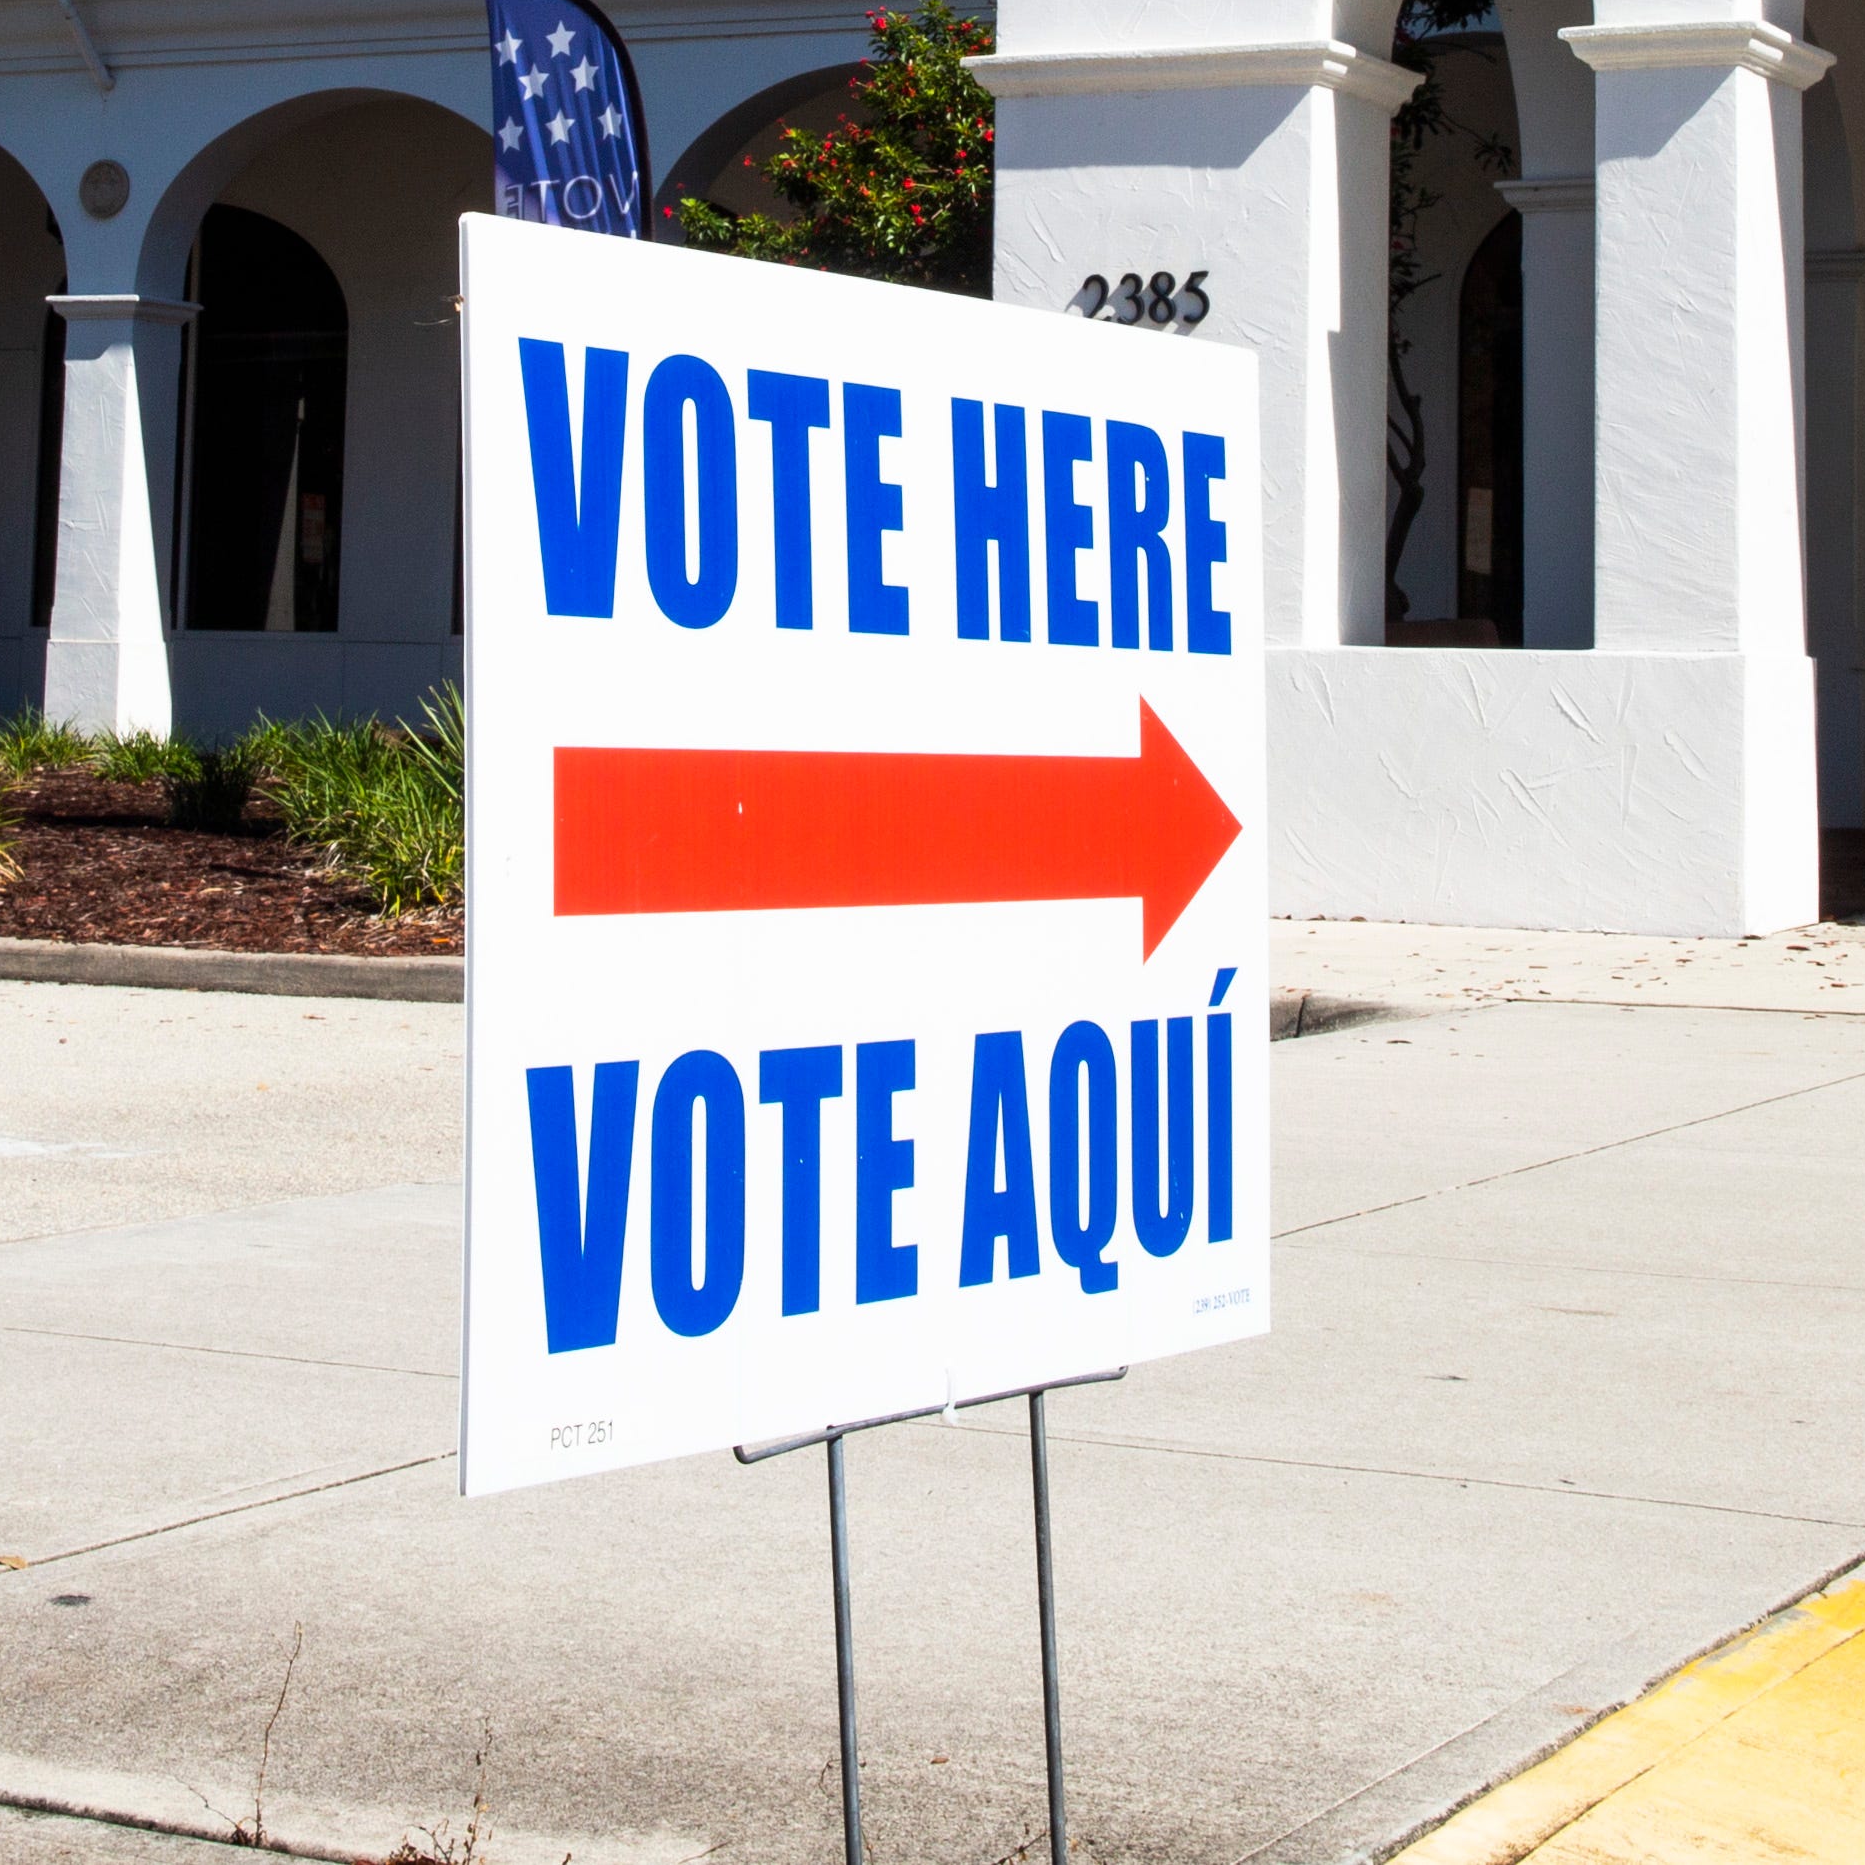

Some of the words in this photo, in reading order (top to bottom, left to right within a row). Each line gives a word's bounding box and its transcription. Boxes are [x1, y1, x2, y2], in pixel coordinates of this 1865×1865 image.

[1083, 271, 1210, 324] 2385
[518, 337, 909, 636] VOTE
[951, 397, 1232, 655] HERE
[526, 1039, 918, 1354] VOTE
[959, 967, 1238, 1295] AQUÍ
[550, 1424, 583, 1451] PCT
[587, 1419, 613, 1444] 251
